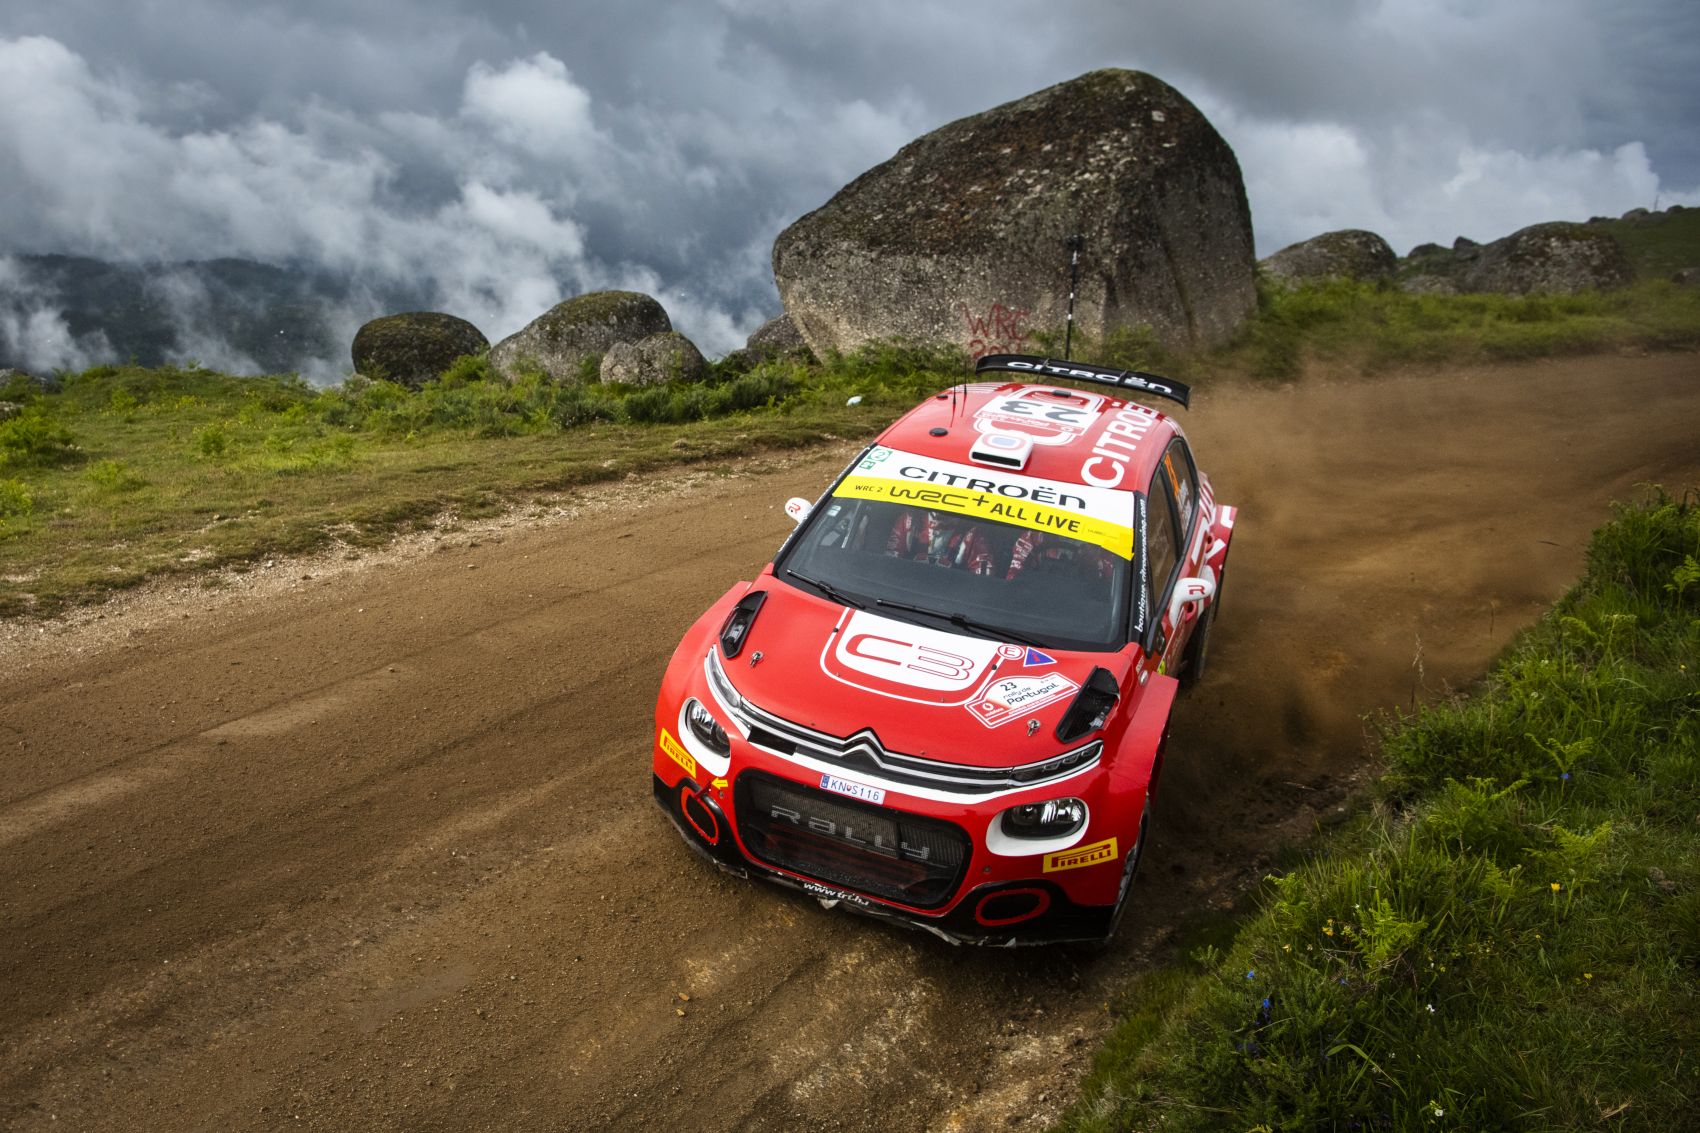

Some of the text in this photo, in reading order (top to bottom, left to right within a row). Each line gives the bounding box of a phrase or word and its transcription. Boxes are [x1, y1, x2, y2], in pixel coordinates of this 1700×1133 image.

[960, 302, 1030, 340] WRC
[1000, 400, 1089, 423] 23
[855, 484, 874, 492] WRC
[990, 503, 1027, 520] ALL
[1034, 512, 1080, 533] LIVE
[845, 633, 975, 680] C3
[1000, 681, 1017, 692] 23
[1006, 682, 1060, 705] Portugal
[663, 735, 693, 772] PIRELLI
[1051, 843, 1112, 868] PIRELLI
